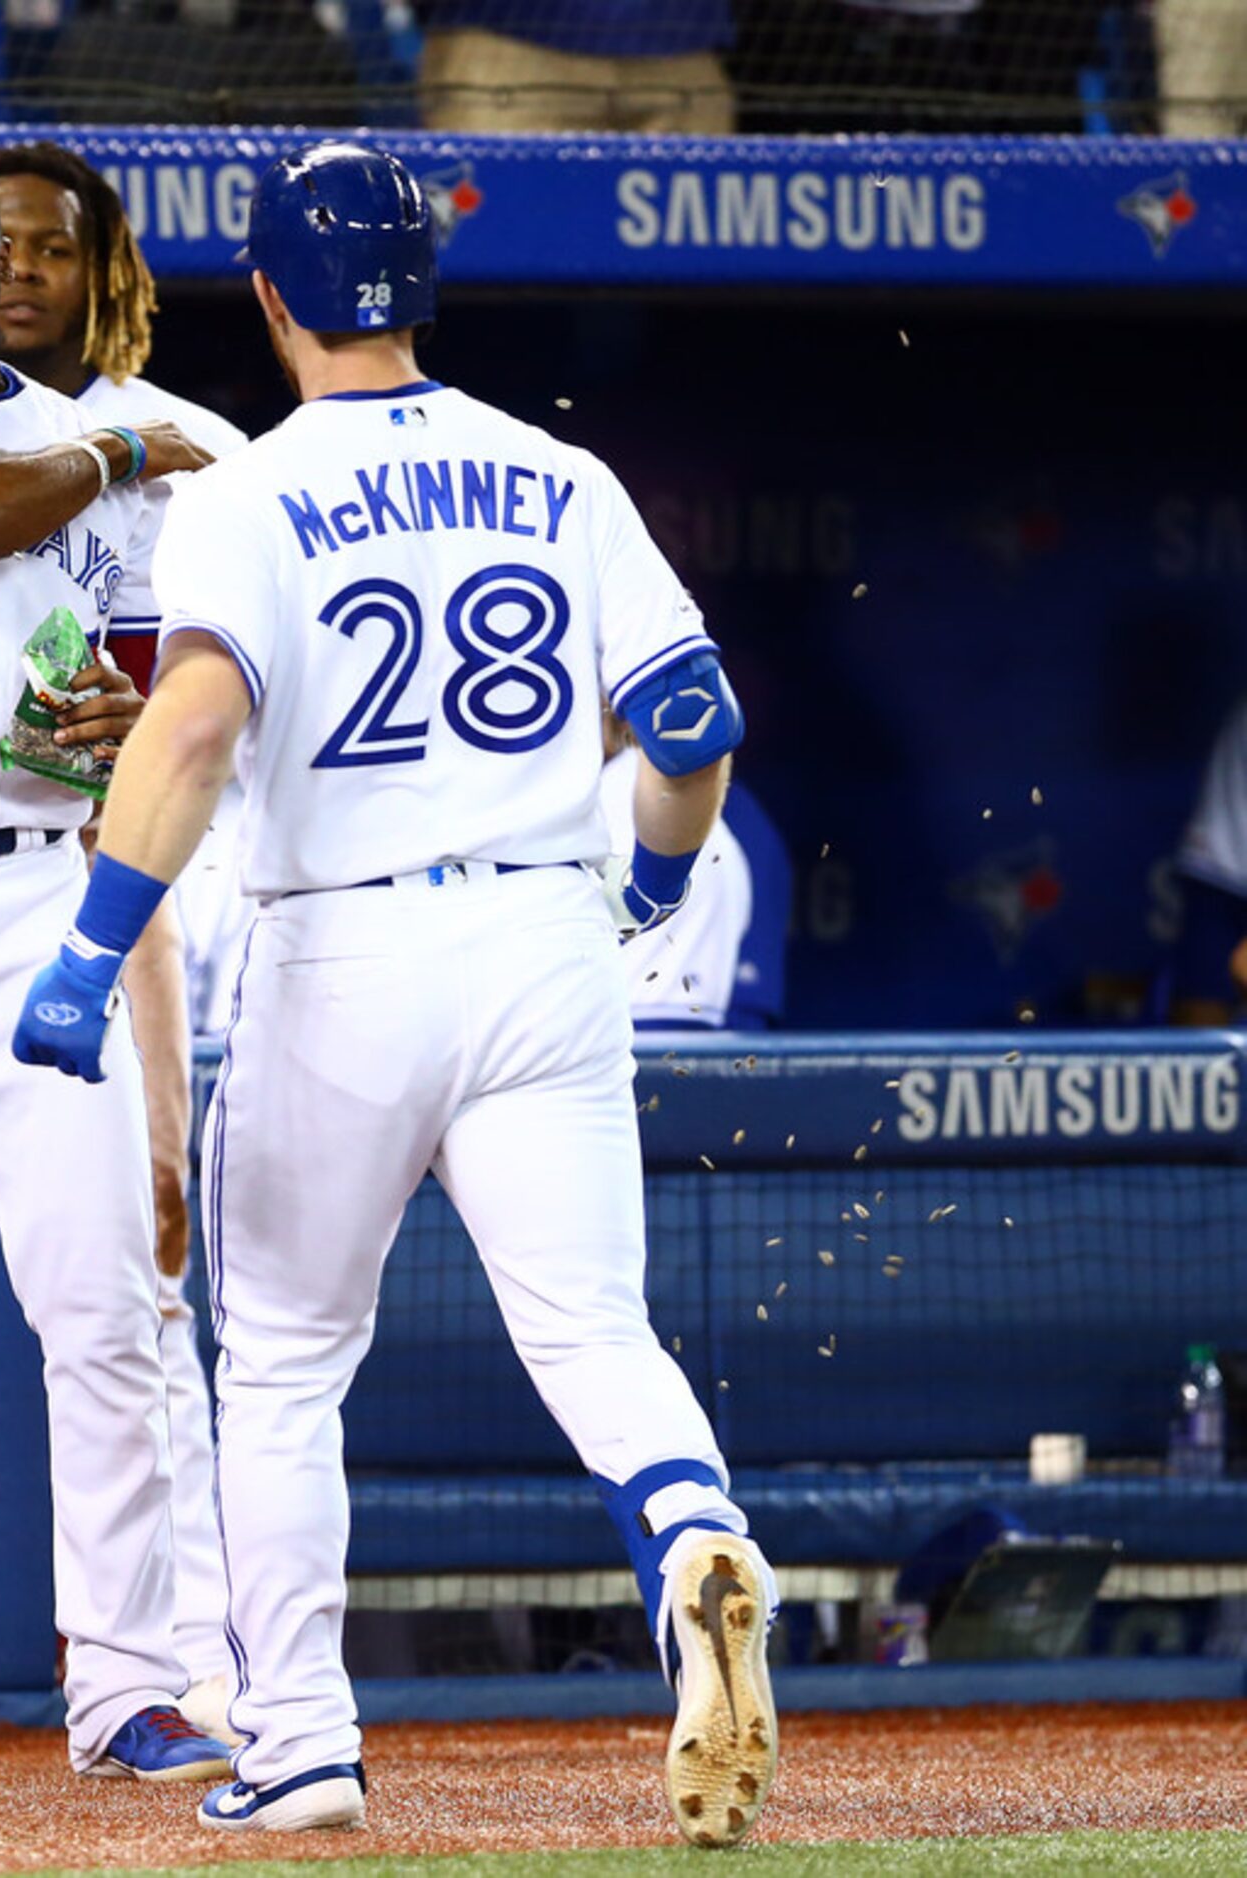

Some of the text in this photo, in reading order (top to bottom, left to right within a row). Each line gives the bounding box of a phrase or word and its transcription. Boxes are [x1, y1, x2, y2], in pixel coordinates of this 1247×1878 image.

[616, 169, 986, 250] SAMSUNG
[356, 282, 392, 308] 28
[309, 563, 574, 769] 28
[897, 1058, 1239, 1143] SAMSUNG
